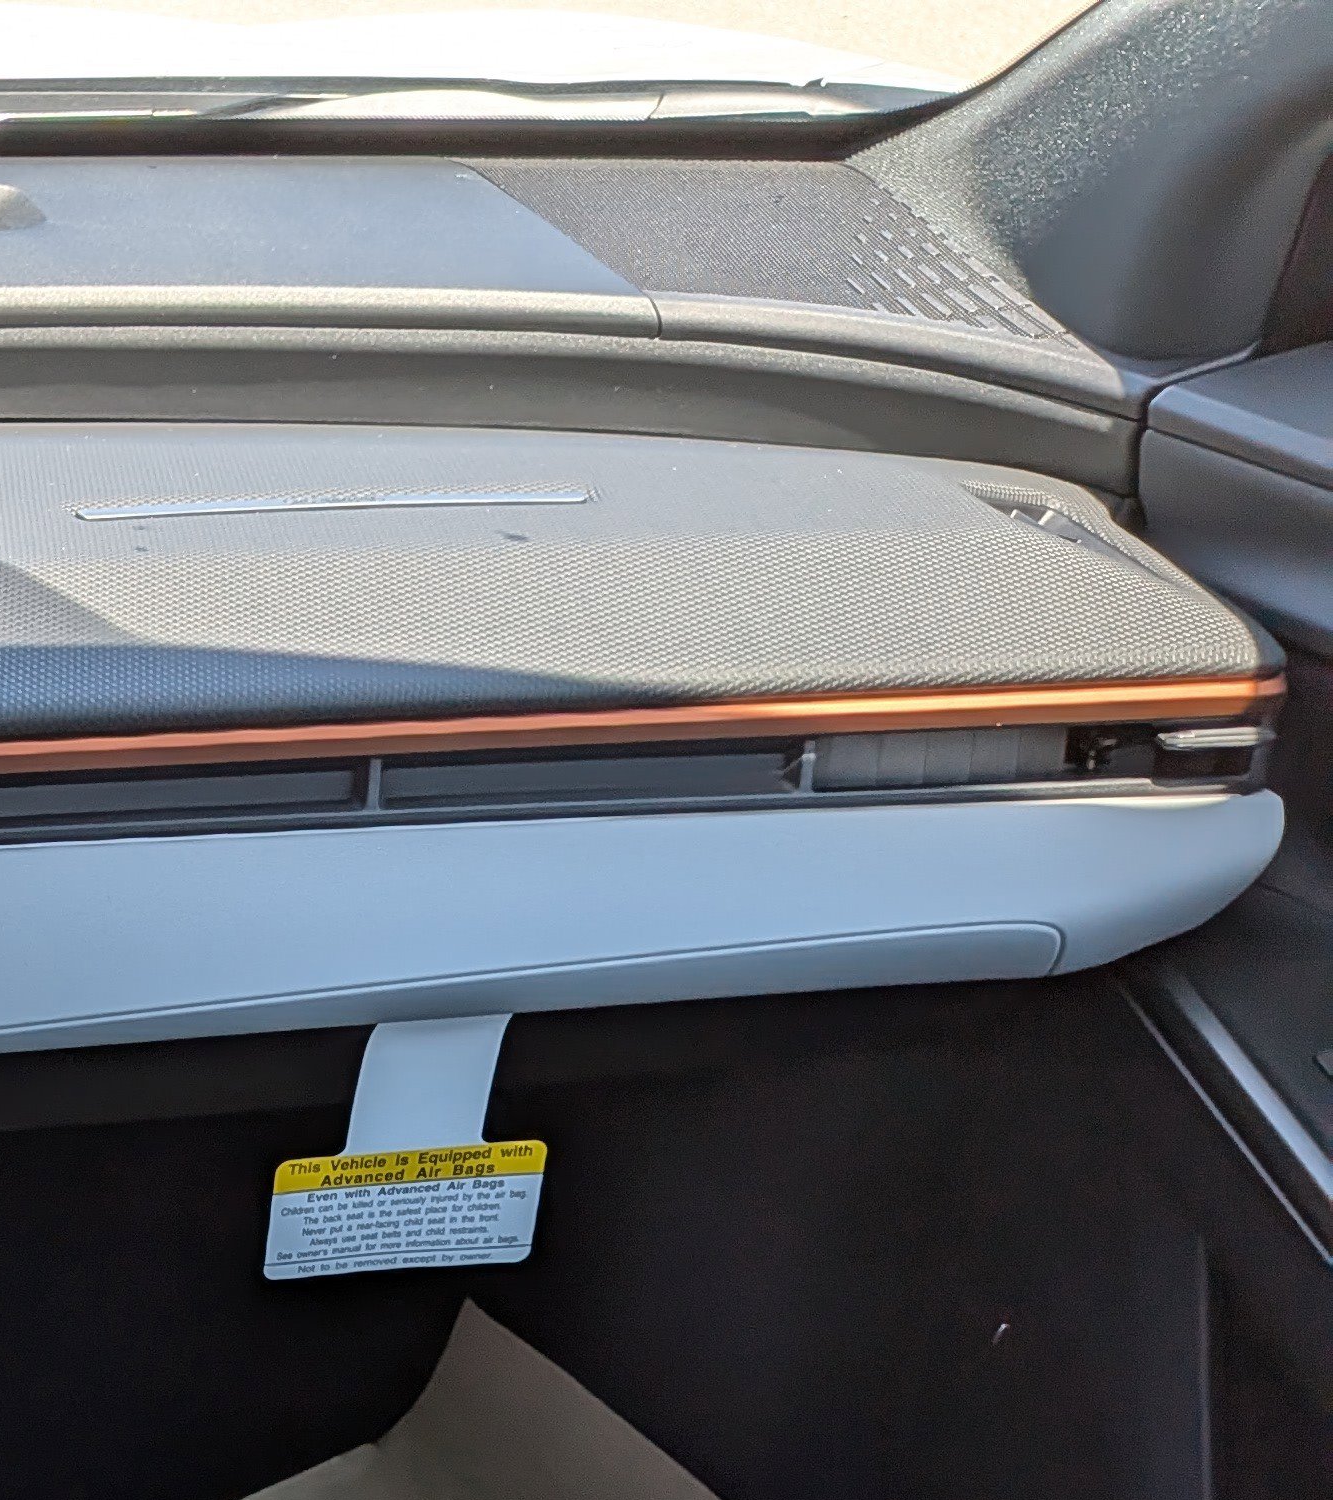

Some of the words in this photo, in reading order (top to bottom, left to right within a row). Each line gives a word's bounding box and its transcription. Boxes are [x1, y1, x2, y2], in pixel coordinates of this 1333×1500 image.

[288, 1161, 321, 1175] This
[330, 1156, 387, 1172] Vehicle
[417, 1147, 492, 1166] Equipped
[500, 1144, 533, 1158] with
[320, 1169, 405, 1187] Advanced
[416, 1166, 441, 1179] Air
[452, 1163, 495, 1177] Bags
[307, 1191, 338, 1203] Even
[344, 1188, 371, 1199] with
[378, 1183, 441, 1197] Advanced
[446, 1181, 466, 1191] Air
[472, 1179, 505, 1190] Bags
[280, 1206, 315, 1217] Children
[304, 1216, 319, 1225] The
[301, 1227, 327, 1236] Never
[297, 1264, 315, 1274] Not
